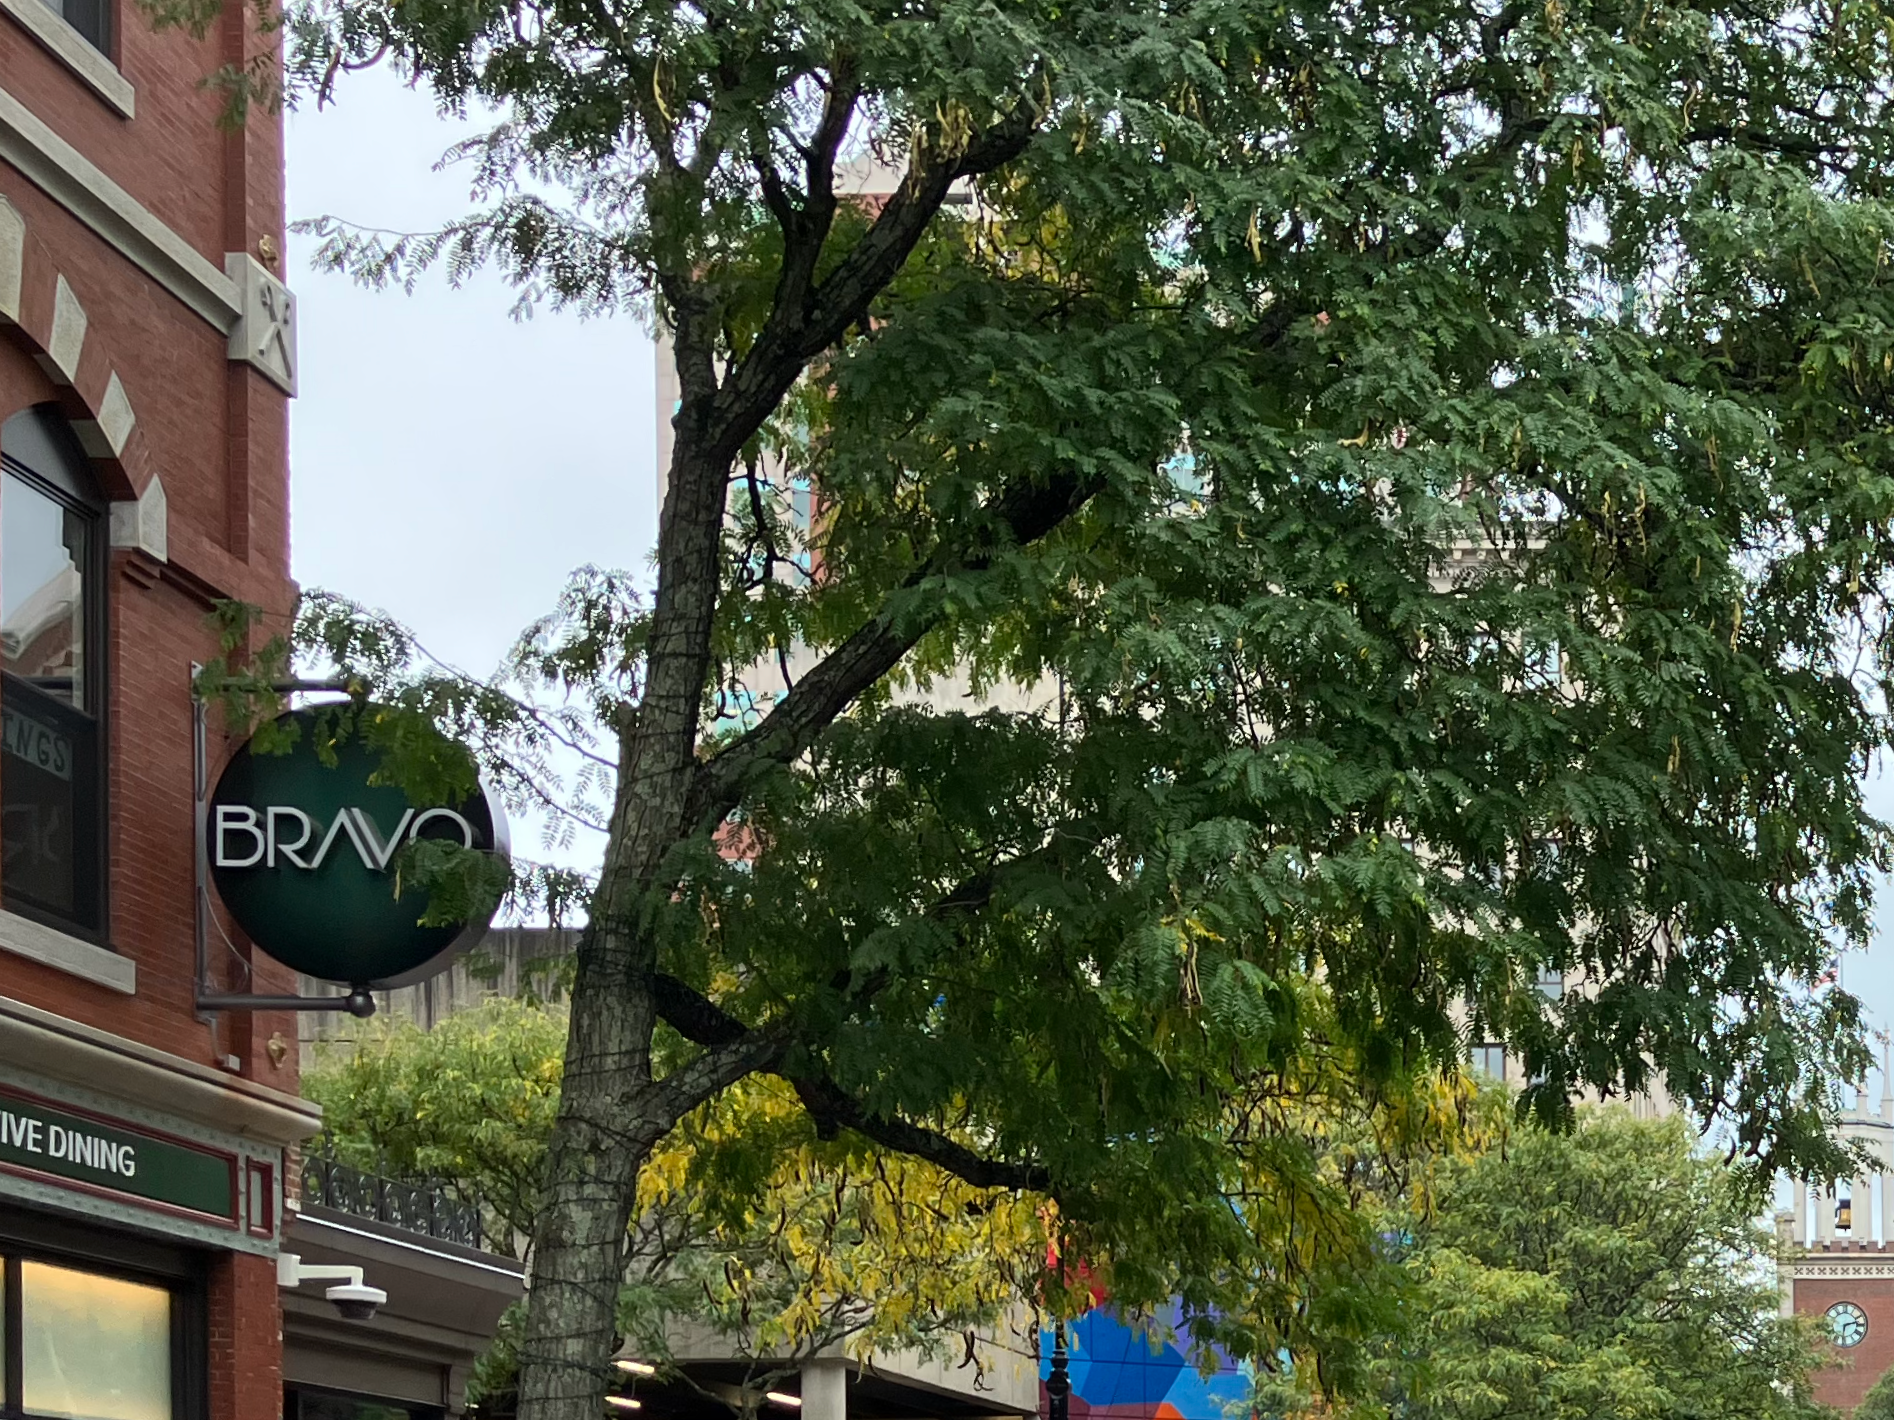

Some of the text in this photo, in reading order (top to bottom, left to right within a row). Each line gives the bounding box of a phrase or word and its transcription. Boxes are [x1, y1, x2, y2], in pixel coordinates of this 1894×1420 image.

[216, 805, 472, 868] BRAVO
[0, 1110, 135, 1176] IVE DINING
